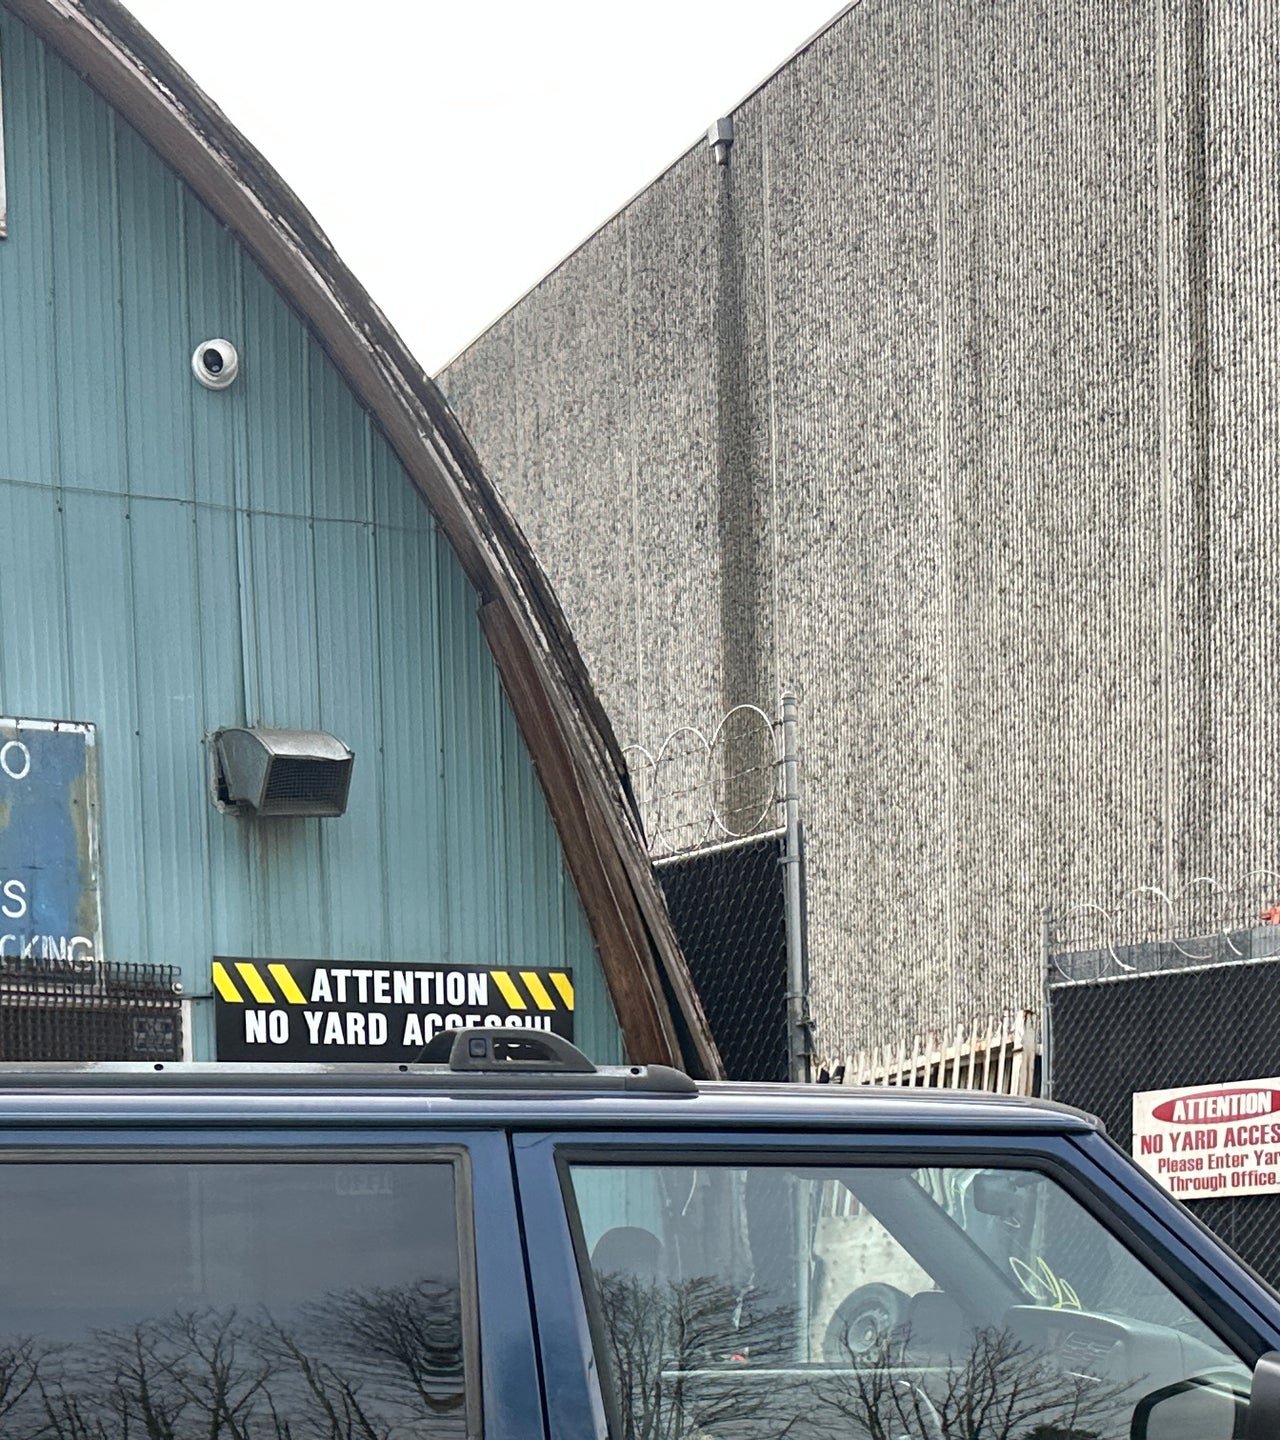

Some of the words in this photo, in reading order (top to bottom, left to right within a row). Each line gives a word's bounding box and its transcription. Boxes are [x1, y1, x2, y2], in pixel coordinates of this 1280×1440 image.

[310, 967, 489, 1005] ATTENTION
[245, 1009, 289, 1044] NO
[303, 1011, 387, 1046] YARD
[1172, 1091, 1272, 1121] ATTENTION
[1141, 1134, 1163, 1155] NO
[1169, 1129, 1218, 1152] YARD
[1158, 1157, 1203, 1173] Please
[1208, 1153, 1249, 1170] Enter
[1169, 1173, 1227, 1192] Through
[1231, 1169, 1280, 1187] Office.
